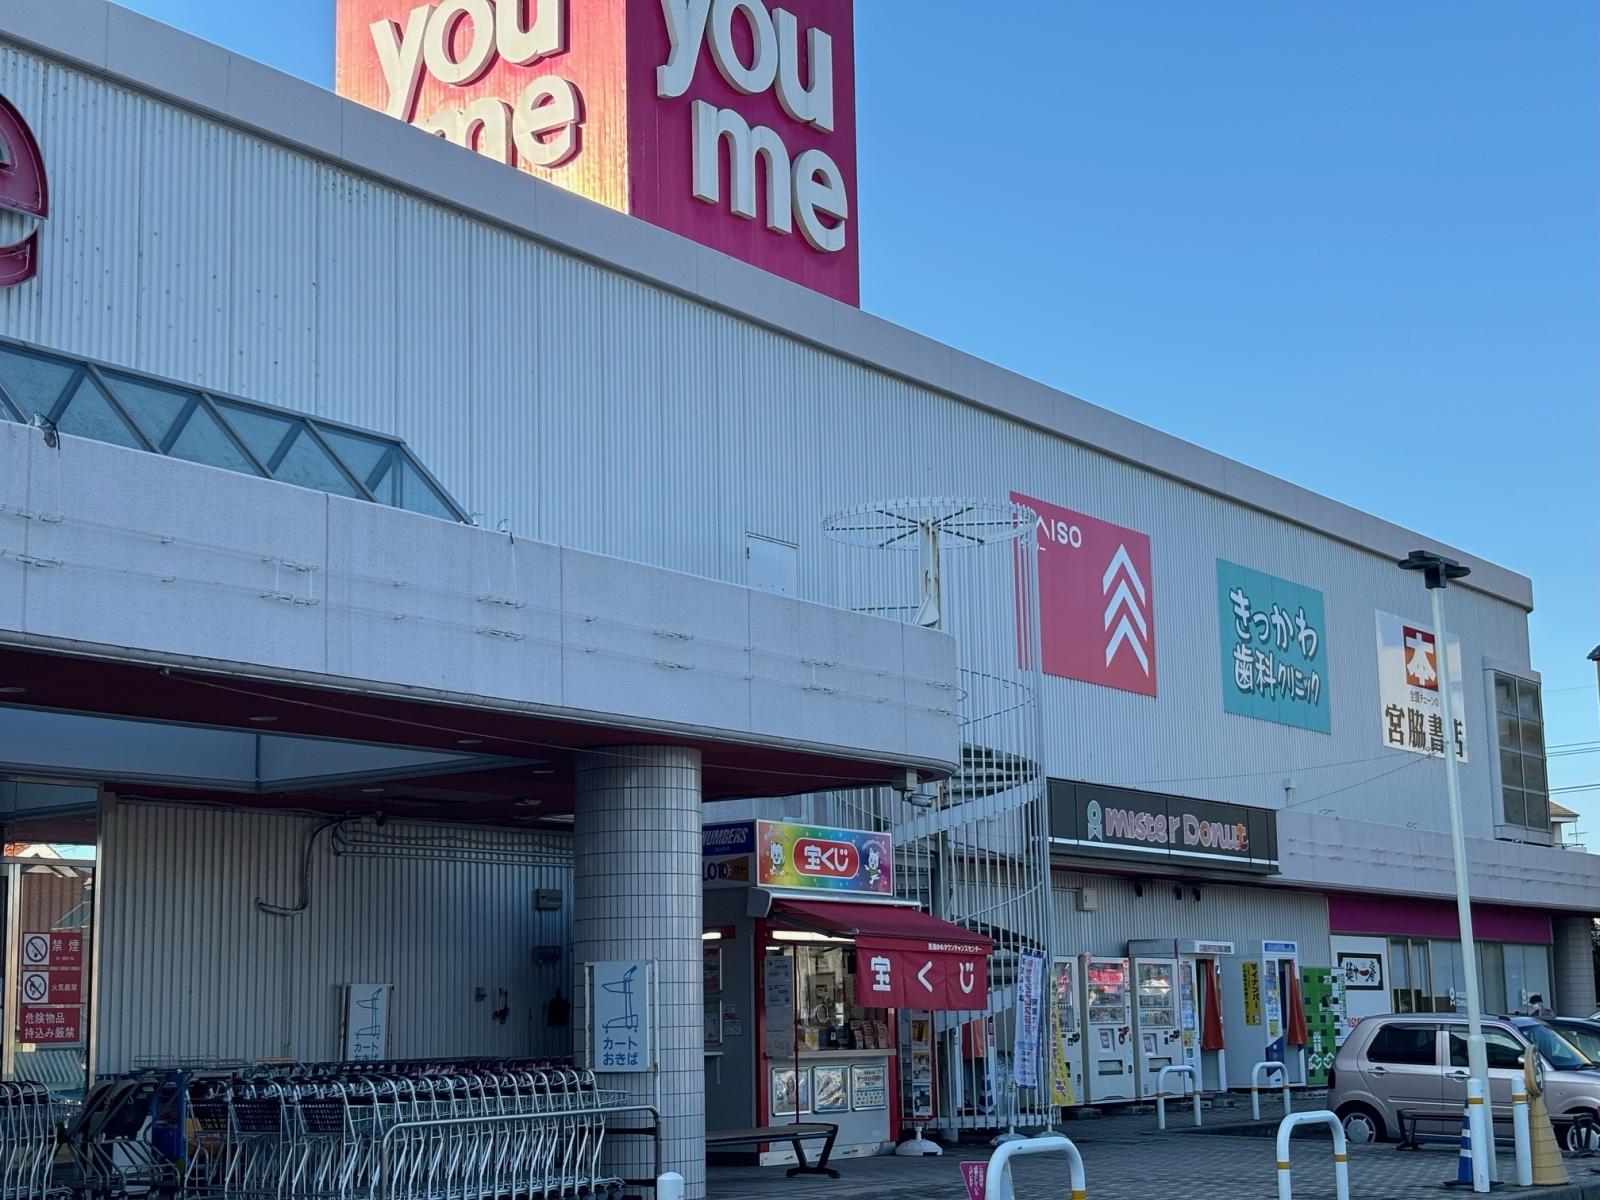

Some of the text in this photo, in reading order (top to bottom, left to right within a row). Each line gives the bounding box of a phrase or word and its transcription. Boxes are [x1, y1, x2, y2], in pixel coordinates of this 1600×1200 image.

[370, 0, 571, 123] you
[657, 0, 835, 133] you
[691, 99, 849, 253] me
[1229, 587, 1319, 660] きっかわ
[1233, 643, 1321, 706] 歯科クリニック
[1183, 813, 1249, 852] Donut
[803, 844, 849, 872] 宝くじ
[52, 940, 80, 952] 禁煙
[870, 955, 975, 994] 宝くじ
[24, 1027, 75, 1040] 持込み厳禁
[25, 1012, 65, 1025] 危険物品
[353, 1042, 379, 1053] カート
[603, 1036, 638, 1051] カート
[603, 1052, 639, 1066] おきば
